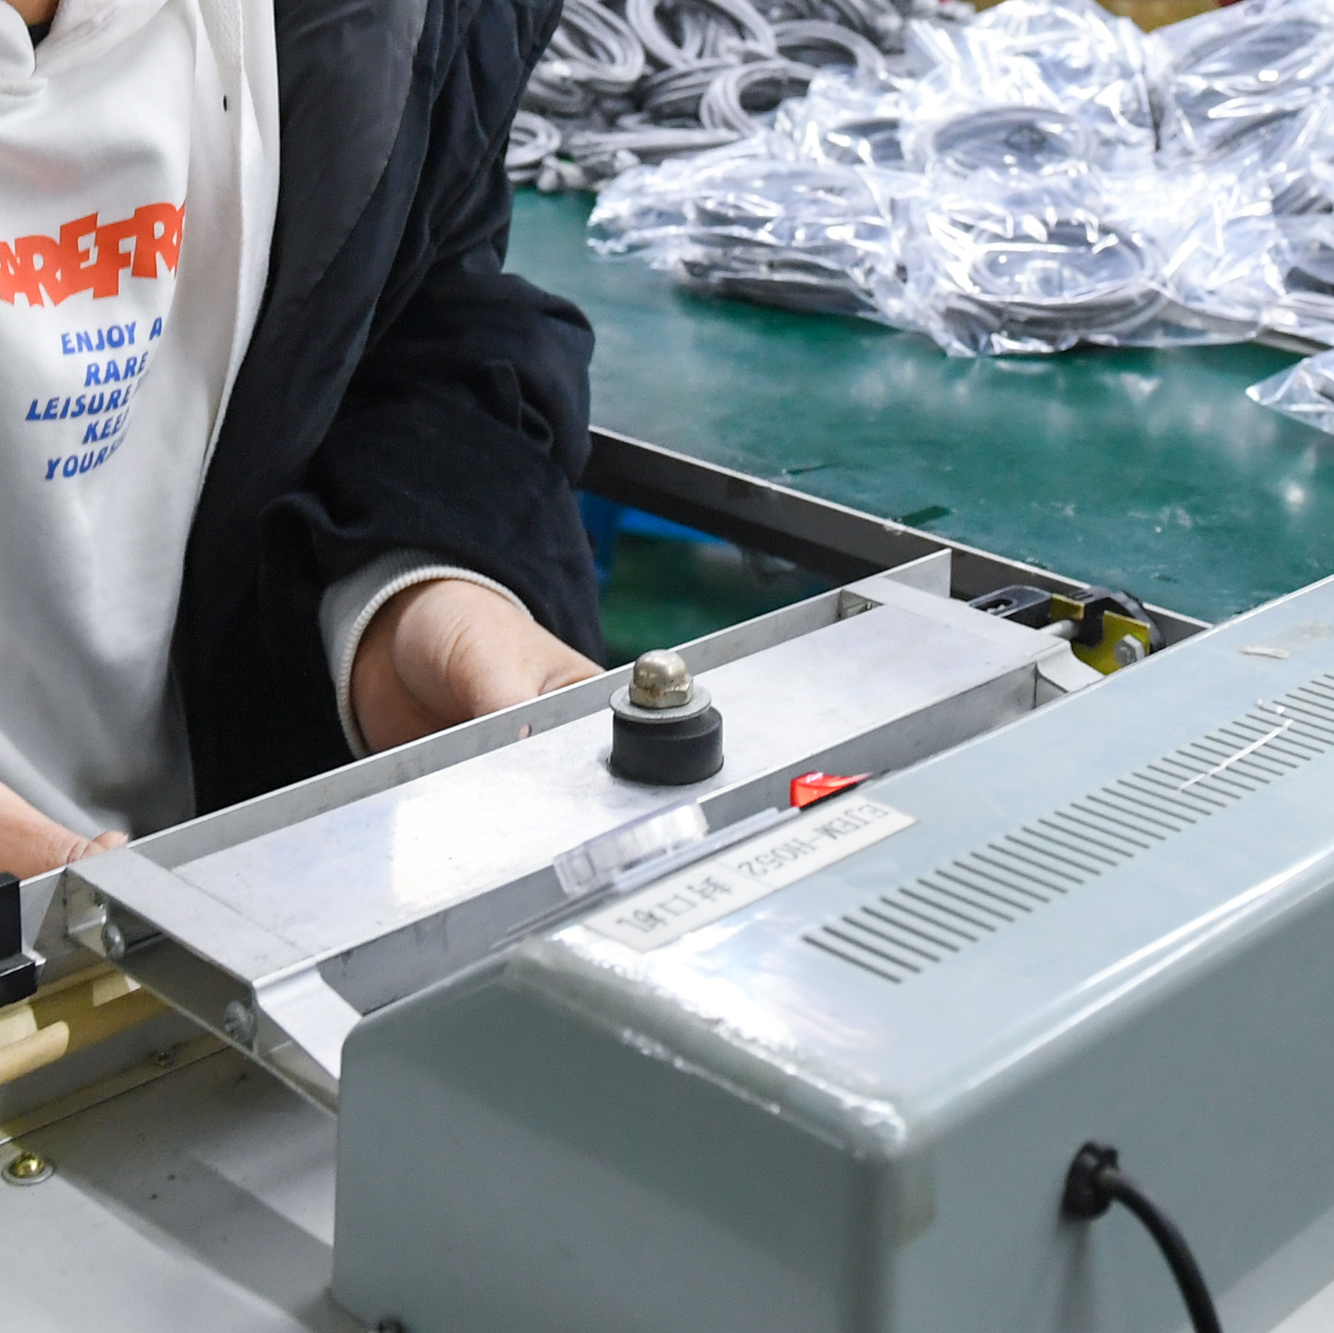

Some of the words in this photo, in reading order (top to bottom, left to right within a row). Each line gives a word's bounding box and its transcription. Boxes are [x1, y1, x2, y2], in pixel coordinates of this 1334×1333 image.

[61, 321, 137, 355] ENJOY
[84, 350, 149, 387] RARE
[25, 383, 132, 421] LEISURE
[617, 875, 733, 933] 封口机
